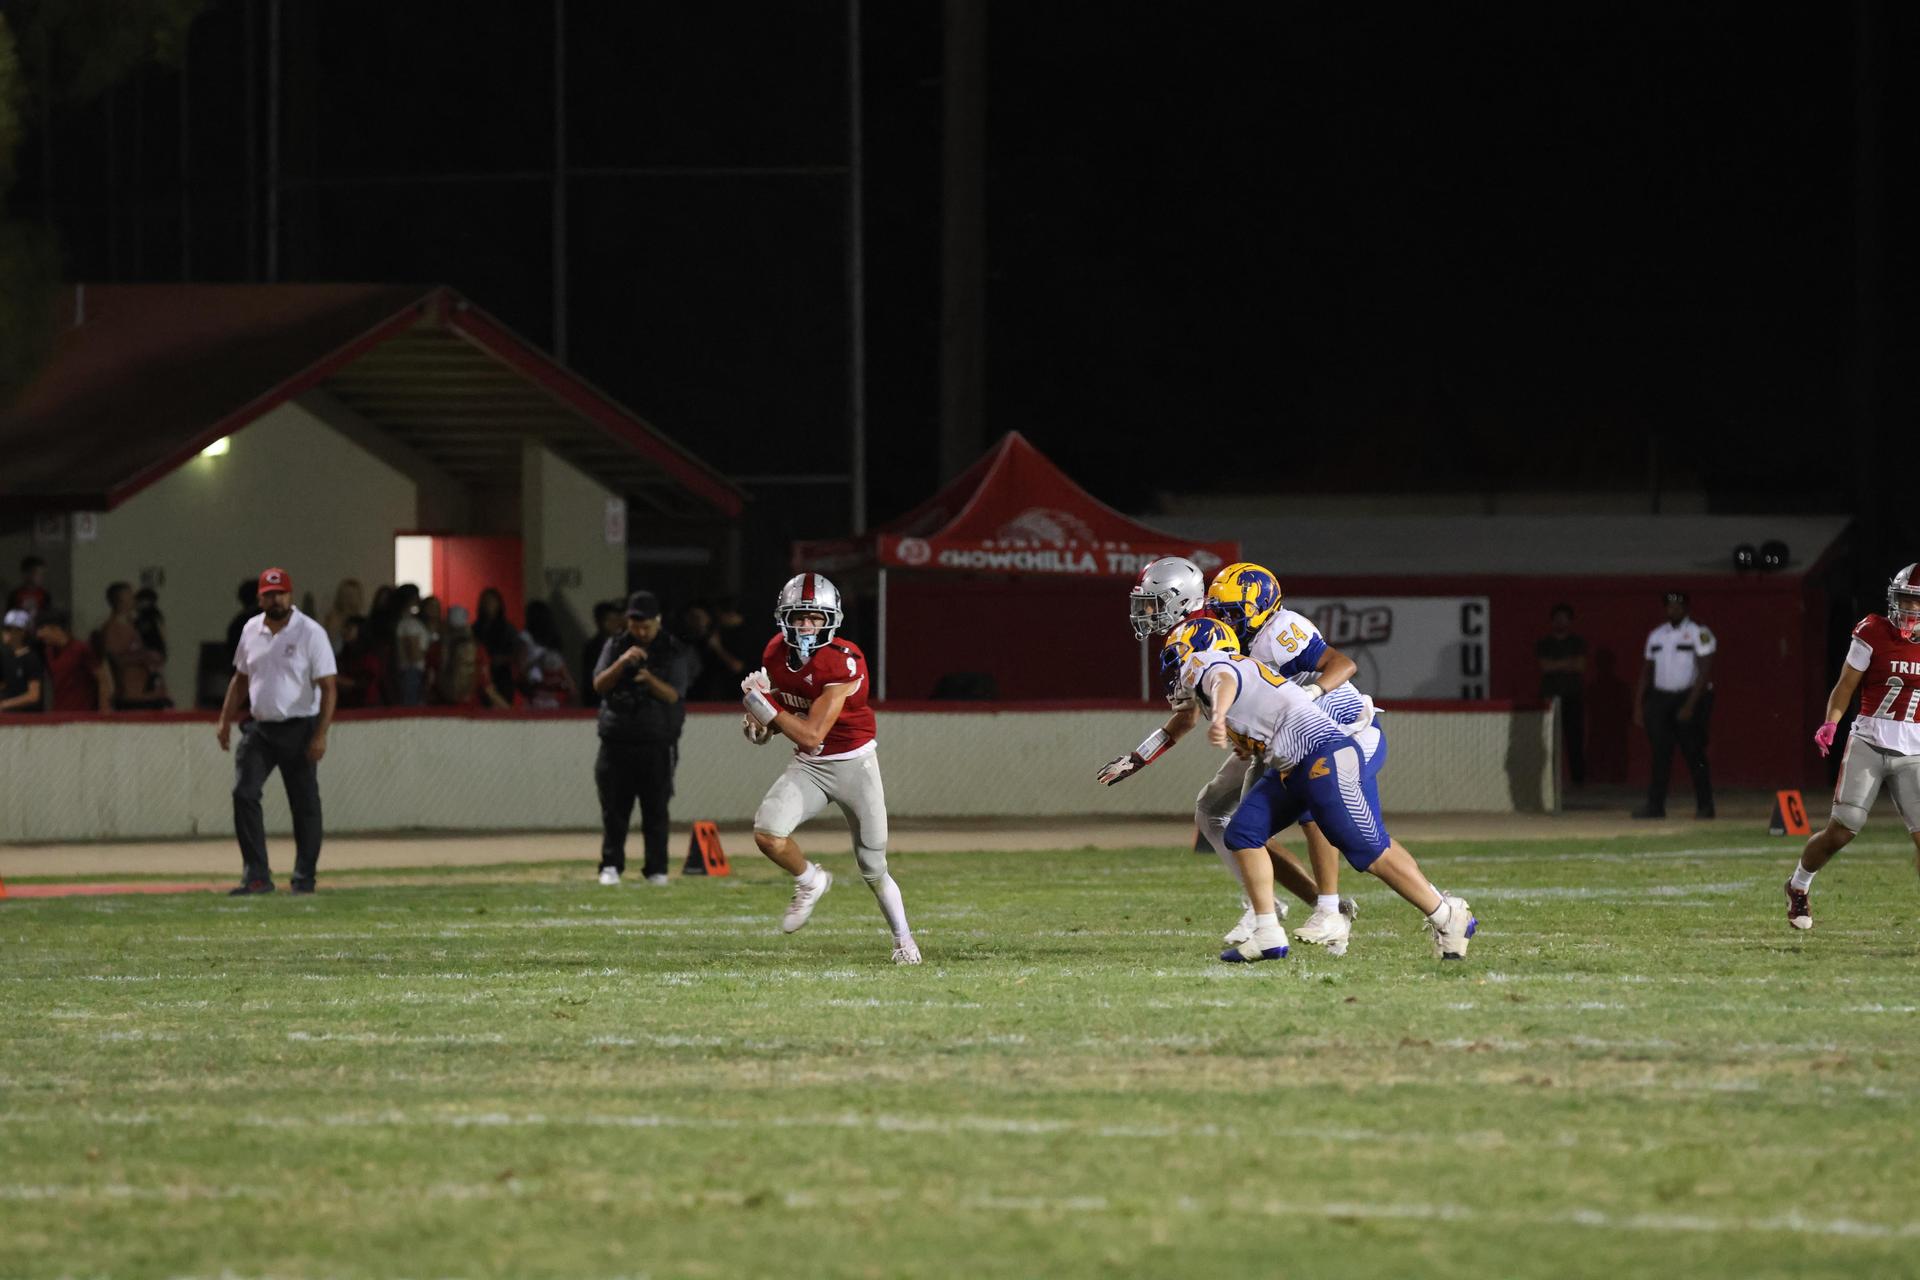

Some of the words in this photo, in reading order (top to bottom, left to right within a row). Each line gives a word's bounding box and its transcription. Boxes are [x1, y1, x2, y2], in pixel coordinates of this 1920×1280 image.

[1276, 622, 1309, 653] 54
[846, 656, 857, 677] 9
[1787, 795, 1804, 828] G
